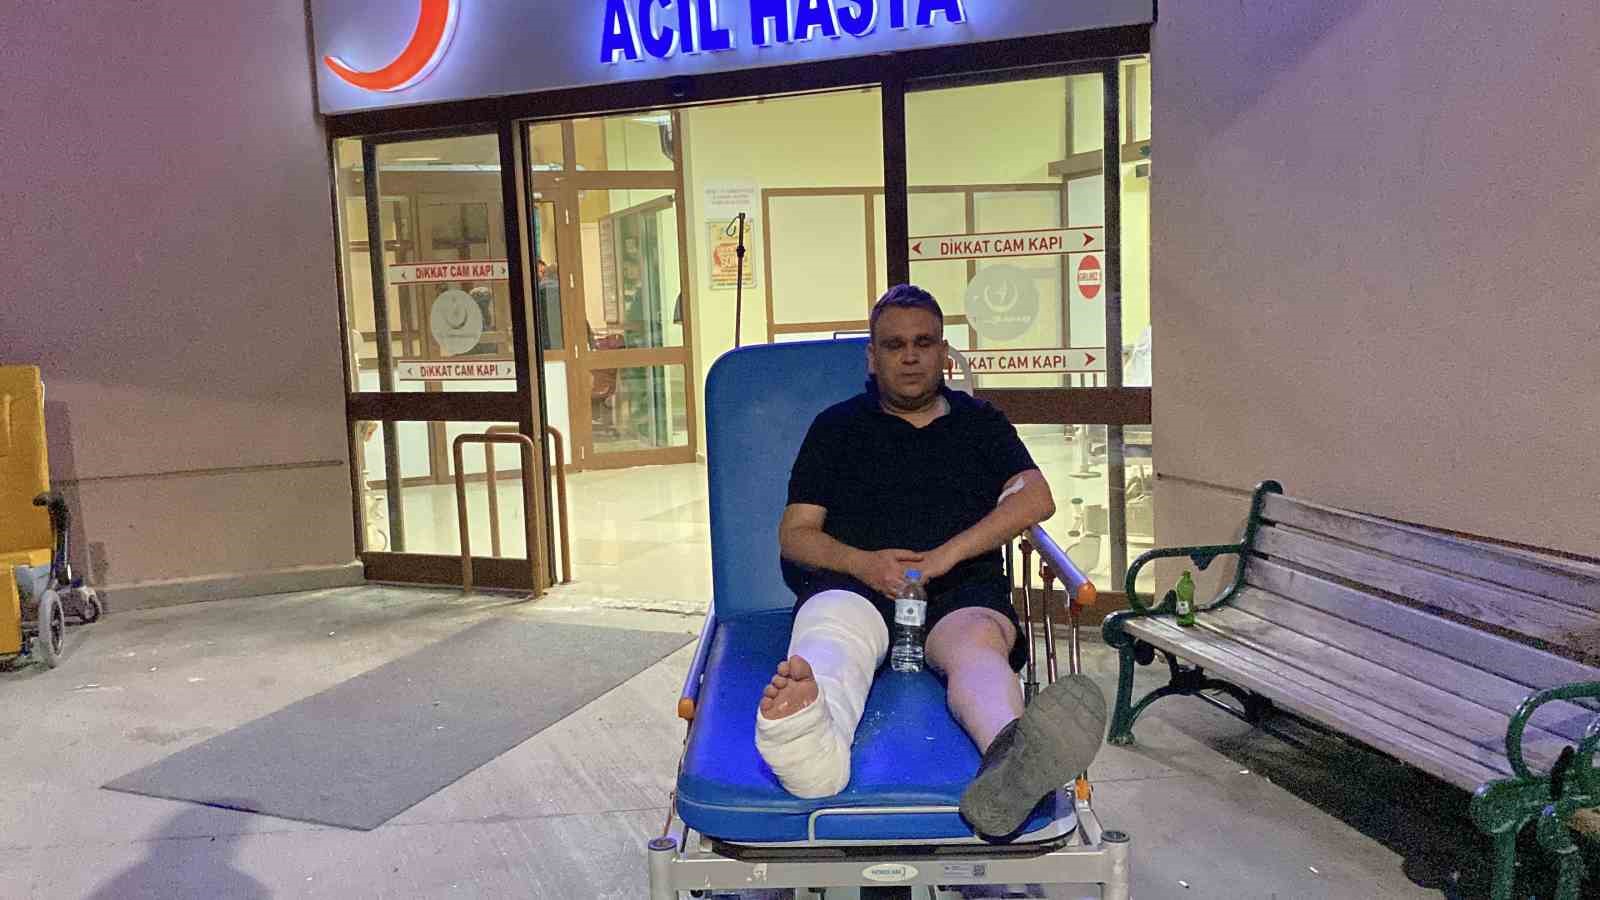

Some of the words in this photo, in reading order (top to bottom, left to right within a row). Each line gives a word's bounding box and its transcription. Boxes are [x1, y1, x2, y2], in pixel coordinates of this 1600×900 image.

[750, 0, 967, 46] HAS
[940, 239, 991, 255] DİKKAT
[994, 239, 1024, 253] CAM
[1028, 236, 1063, 251] KAPI
[450, 264, 470, 278] CAM
[472, 263, 494, 277] KAPI
[998, 356, 1028, 369] CAM
[1032, 354, 1066, 368] KAPI
[454, 364, 474, 376] CAM
[476, 364, 498, 376] KAPI
